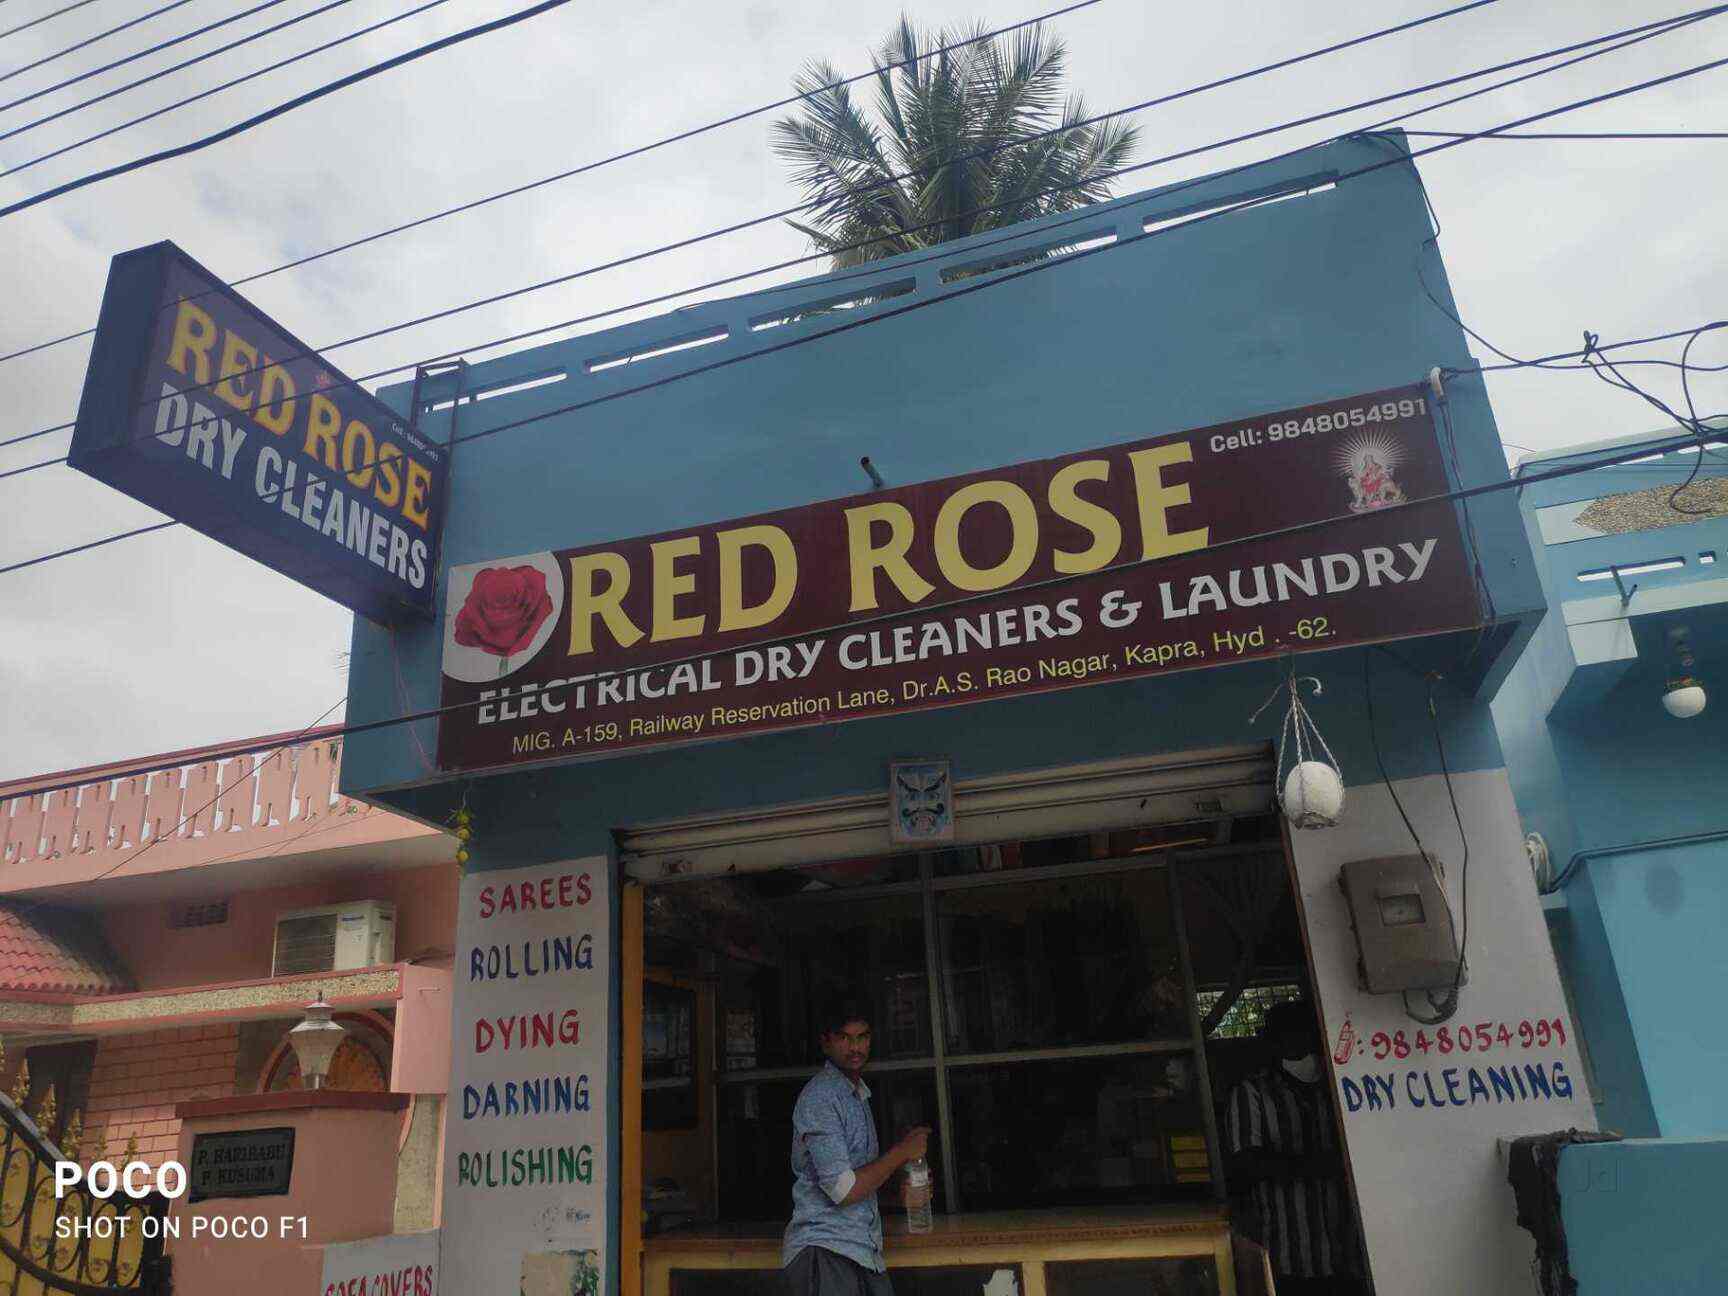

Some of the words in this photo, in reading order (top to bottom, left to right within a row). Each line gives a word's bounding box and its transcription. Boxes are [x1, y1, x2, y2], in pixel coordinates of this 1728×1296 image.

[166, 297, 296, 437] RED
[303, 393, 432, 531] ROSE
[1209, 427, 1262, 453] Cell:
[1267, 397, 1427, 441] 9848054991
[154, 382, 248, 480] DRY
[255, 446, 428, 590] CLEANERS
[567, 524, 798, 656] RED
[844, 441, 1210, 613] ROSE
[478, 659, 722, 726] ELECTRICAL
[735, 639, 826, 686] DRY
[838, 598, 1084, 670] CLEANERS
[1099, 590, 1142, 629] &
[1158, 537, 1438, 620] LAUNDRY
[630, 713, 705, 737] Railway
[711, 695, 831, 726] Reservation
[838, 688, 896, 710] Lane,
[986, 667, 1032, 688] Rao
[1038, 653, 1118, 680] Nagar,
[1124, 641, 1205, 667] Kapra,
[479, 872, 593, 919] SAREES
[470, 933, 594, 982] ROLLING
[475, 1009, 580, 1054] DYING
[463, 1074, 591, 1120] DARNING
[1341, 1071, 1396, 1113] DRY
[1406, 1060, 1573, 1109] CLEANING
